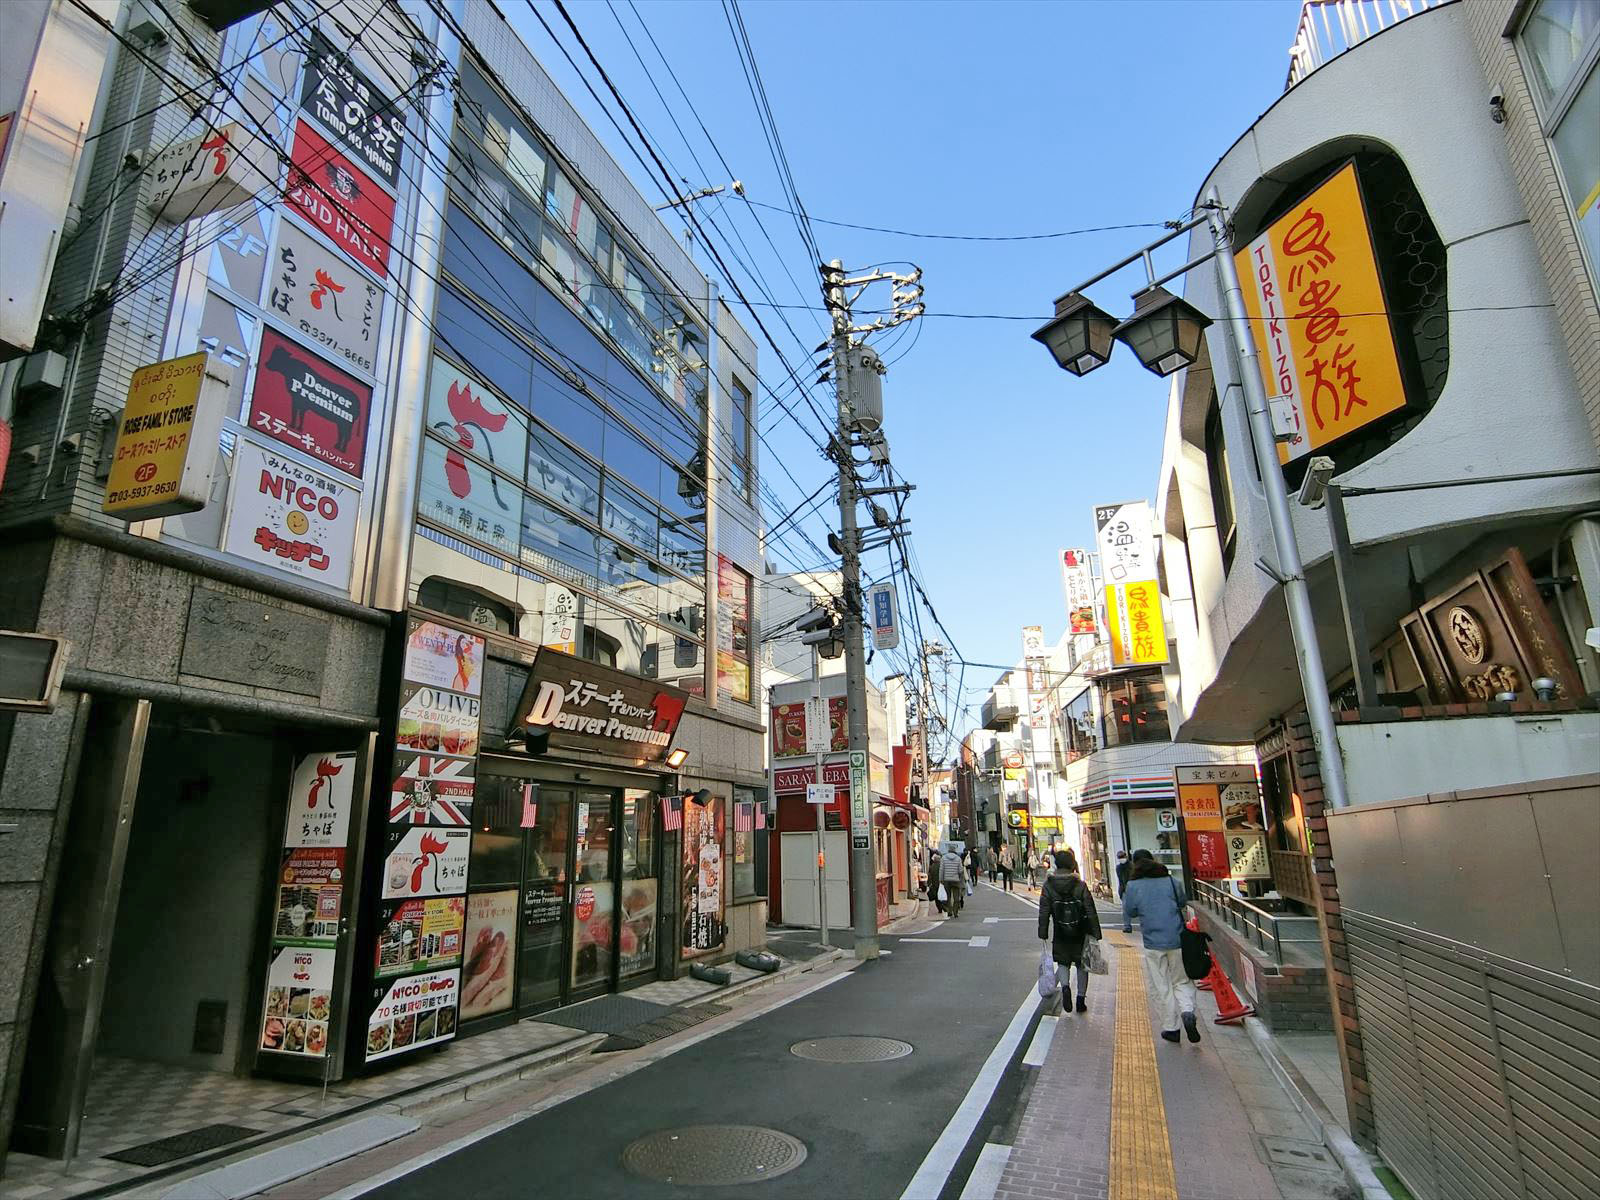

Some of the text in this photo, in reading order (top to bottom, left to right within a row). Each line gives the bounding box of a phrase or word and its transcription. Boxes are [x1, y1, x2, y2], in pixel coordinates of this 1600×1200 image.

[315, 100, 347, 136] TOMO
[363, 144, 394, 177] HANA
[154, 189, 169, 202] 2F
[218, 217, 268, 258] 2F
[335, 218, 382, 261] HALF
[271, 246, 298, 317] ちゃぼ
[361, 283, 378, 342] やきとり
[290, 378, 353, 423] Premium
[304, 372, 352, 409] Denver
[141, 410, 168, 430] FAMILY
[167, 404, 193, 425] STORE
[138, 467, 154, 480] 2F
[268, 457, 337, 495] みんなの酒場
[118, 481, 177, 501] 03-5937-9630
[259, 469, 340, 520] NICO
[1097, 508, 1116, 521] 2F
[254, 527, 331, 571] キッチン
[420, 688, 479, 719] OLIVE
[525, 680, 671, 747] Denver Premium
[445, 787, 458, 796] 2ND
[778, 772, 814, 787] SARAY
[302, 820, 335, 837] ちゃぼ
[294, 957, 312, 965] NICO
[392, 984, 420, 1000] NICO
